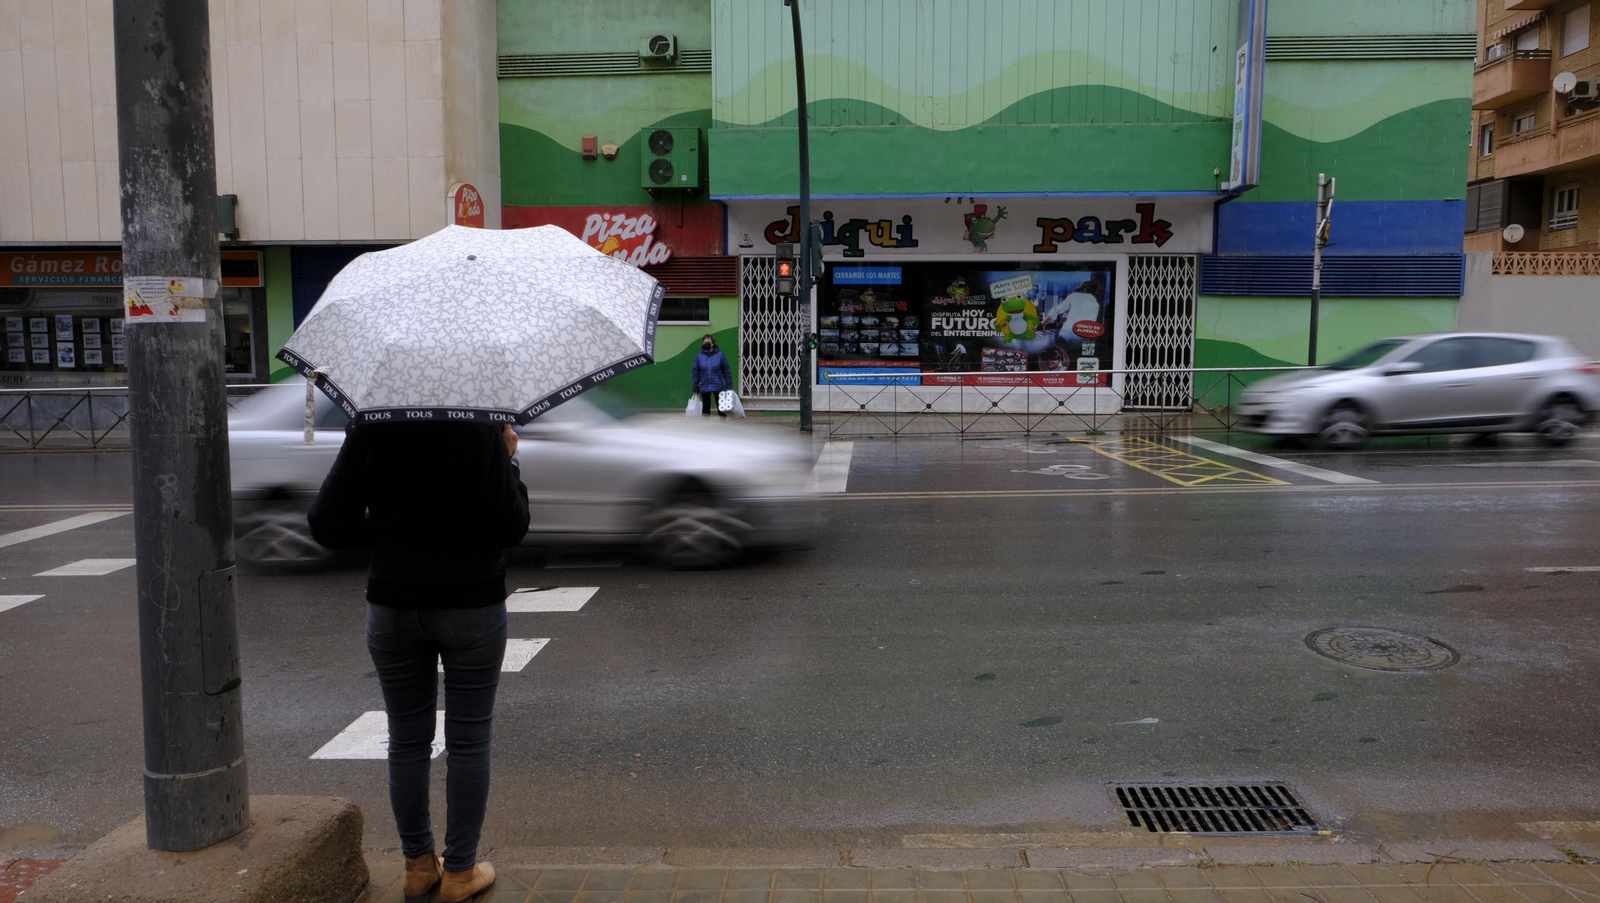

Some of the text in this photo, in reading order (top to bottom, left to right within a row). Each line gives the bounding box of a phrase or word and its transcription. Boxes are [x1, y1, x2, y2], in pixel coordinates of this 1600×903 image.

[581, 213, 656, 244] Pizza
[1033, 203, 1174, 253] park
[10, 255, 123, 273] Gámez Ro
[834, 271, 900, 280] CERRAMOS LOS MARTES
[962, 309, 985, 317] HOY
[283, 352, 299, 367] TOUS
[323, 382, 338, 399] TOUS
[341, 400, 356, 419] TOUS
[528, 356, 647, 418] TOUS TOUS TOUS TOUS
[364, 410, 516, 422] TOUS TOUS TOUS TOUS
